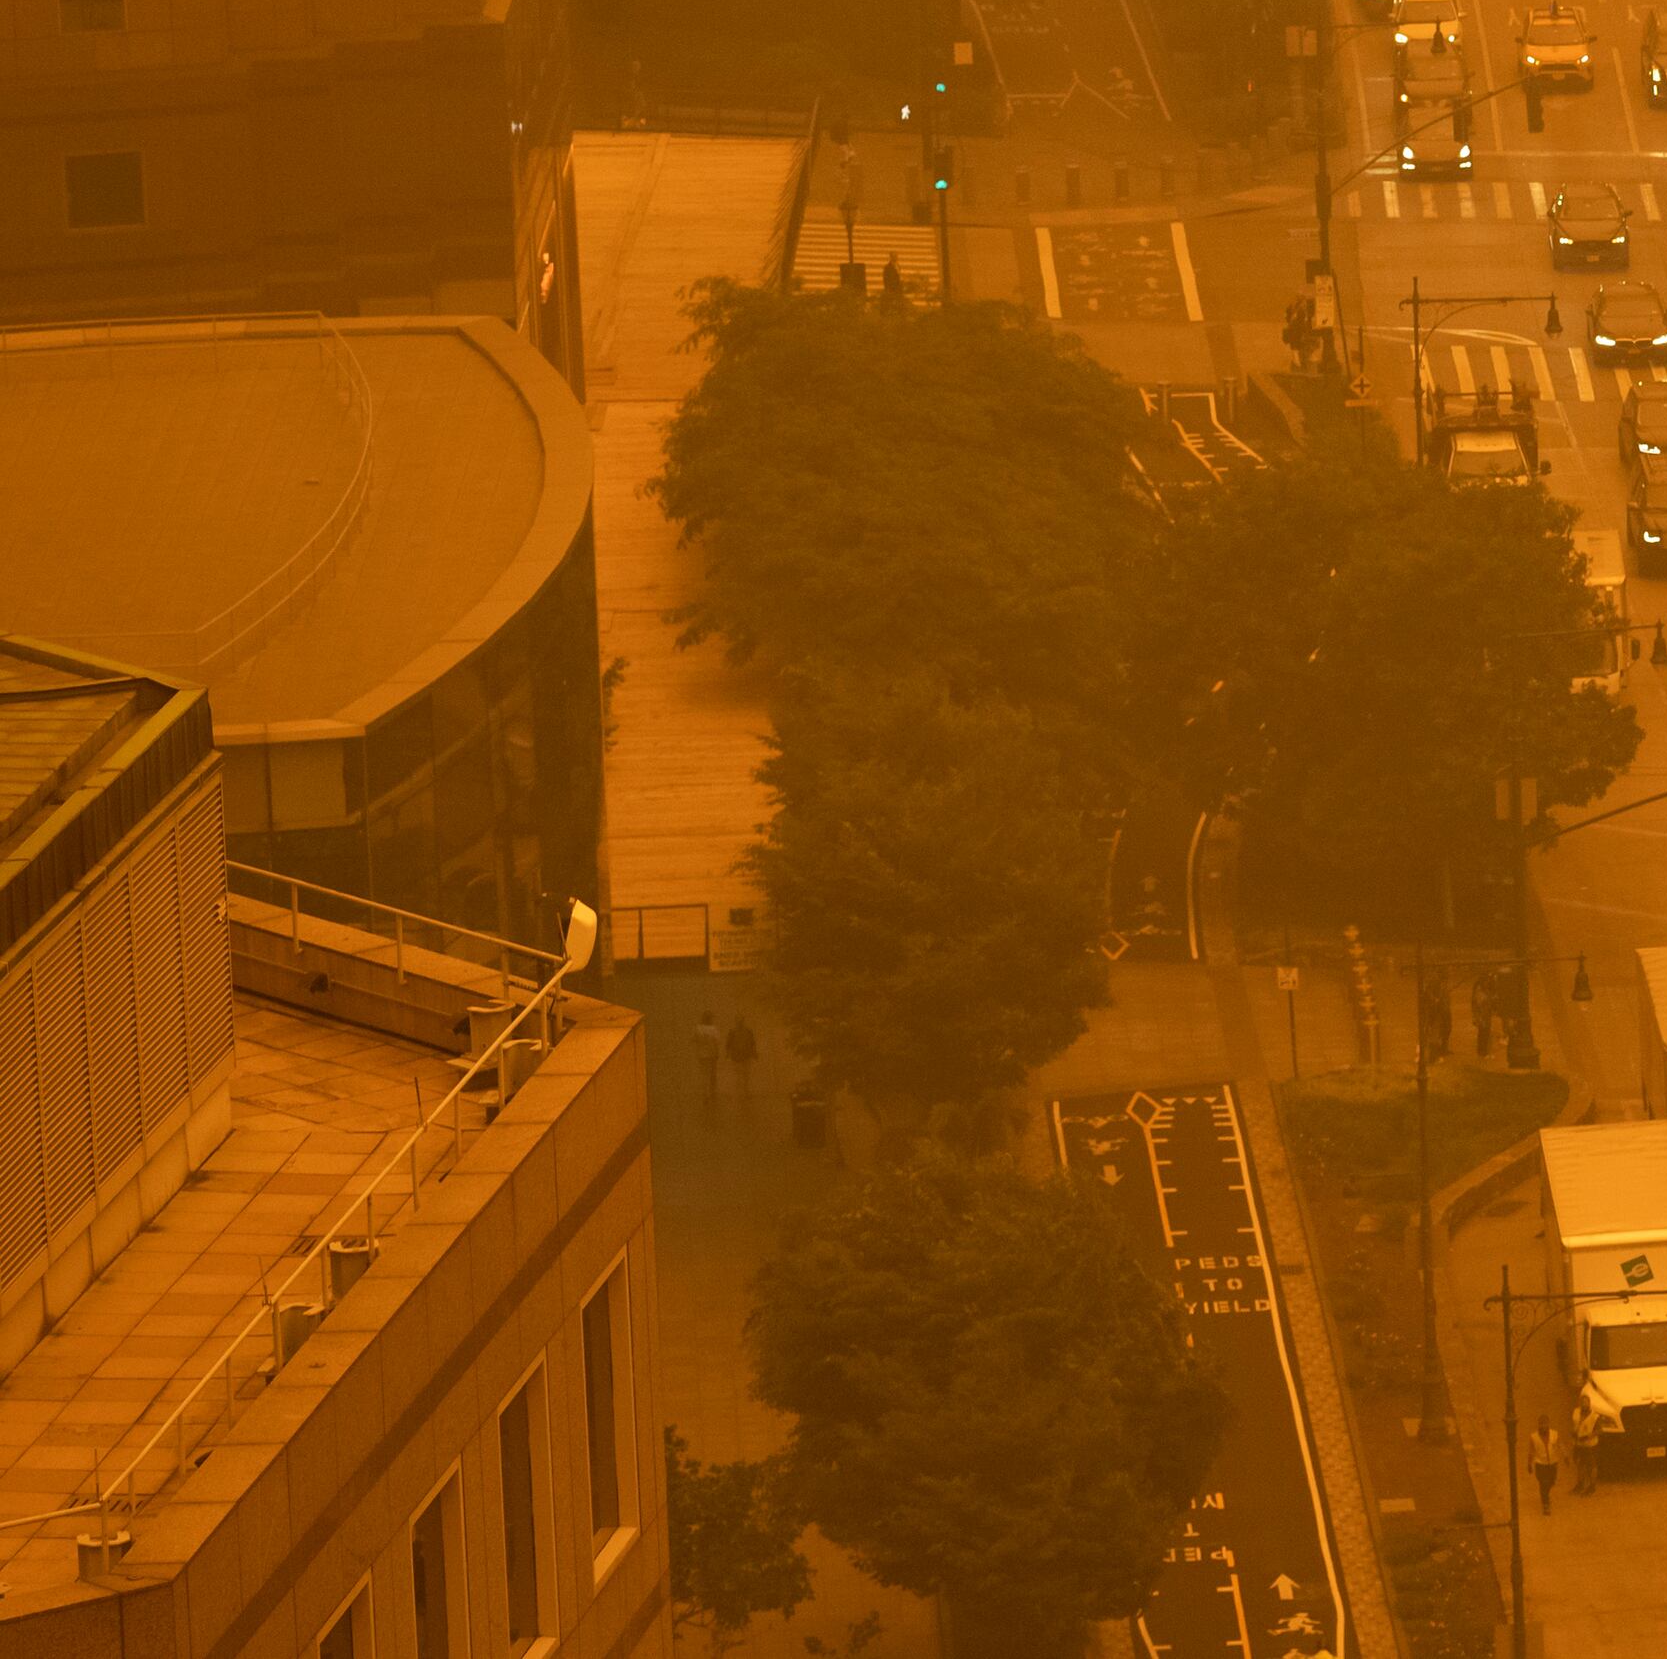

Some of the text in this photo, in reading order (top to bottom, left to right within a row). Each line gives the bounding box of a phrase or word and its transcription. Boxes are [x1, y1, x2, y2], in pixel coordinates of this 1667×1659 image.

[1174, 1255, 1263, 1271] PEDS
[1202, 1278, 1243, 1292] TO
[1185, 1299, 1271, 1315] YIELD
